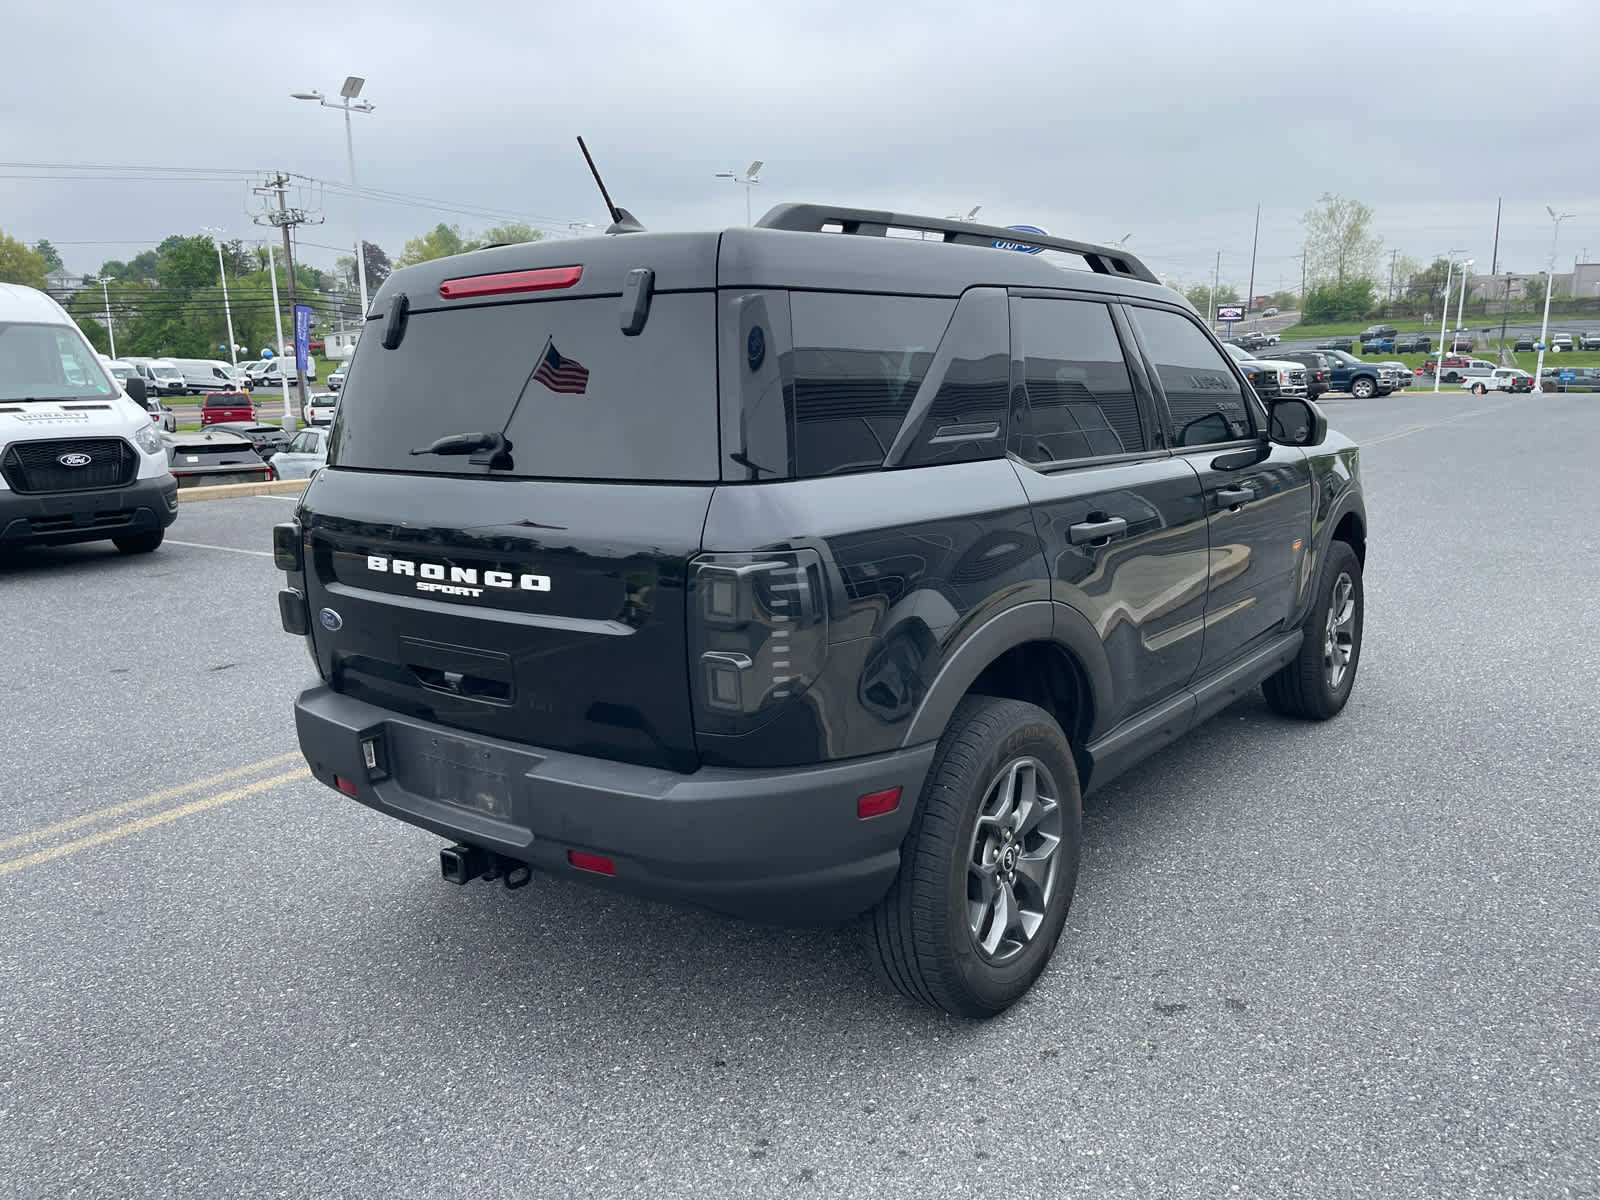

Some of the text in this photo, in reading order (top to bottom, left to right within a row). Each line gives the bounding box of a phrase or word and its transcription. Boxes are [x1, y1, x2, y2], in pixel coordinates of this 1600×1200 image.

[64, 455, 88, 465] Ford
[368, 556, 551, 592] BRONCO
[416, 582, 483, 597] SPORT
